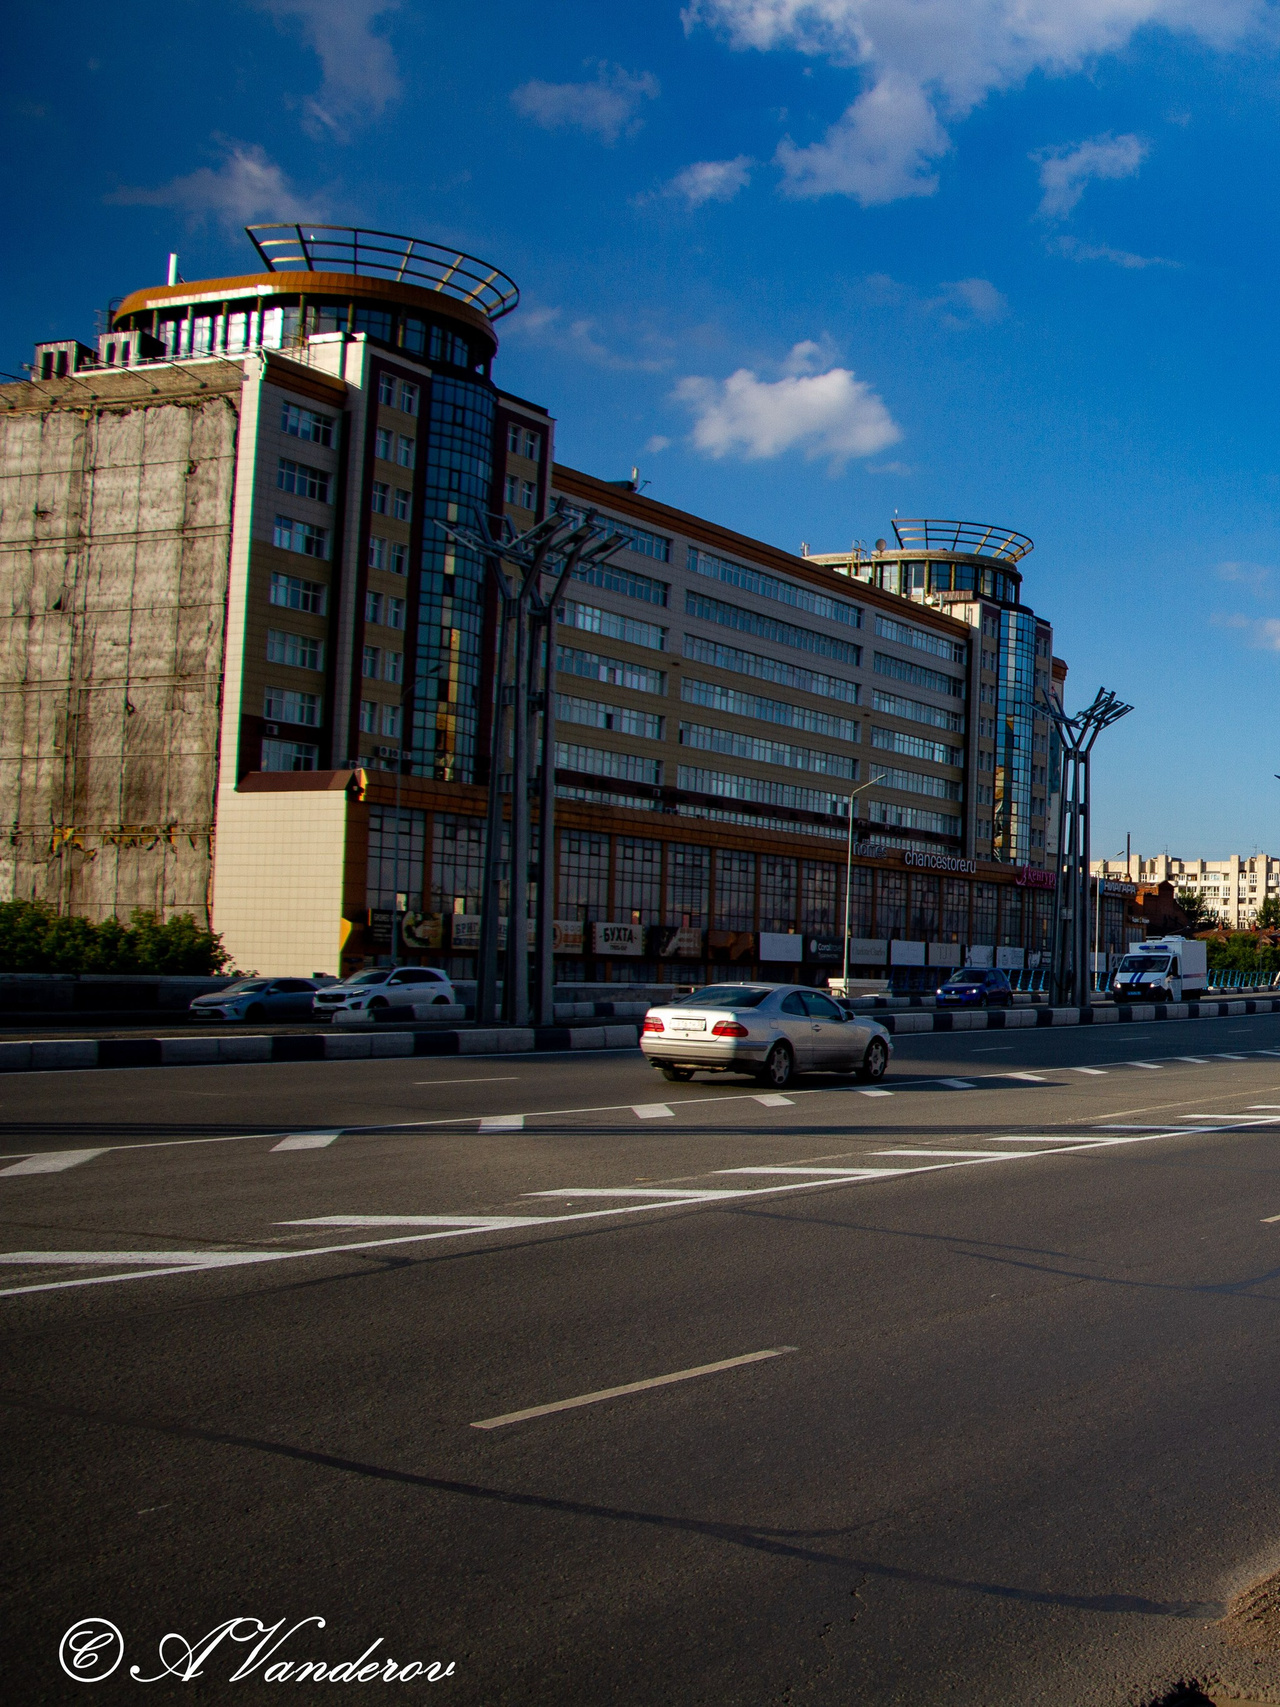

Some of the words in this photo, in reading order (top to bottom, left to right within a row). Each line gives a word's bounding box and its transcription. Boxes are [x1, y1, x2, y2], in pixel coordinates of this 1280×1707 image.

[904, 844, 977, 875] chancestore.ru
[1104, 881, 1137, 895] НИАГАРА
[603, 927, 634, 944] БУХТА
